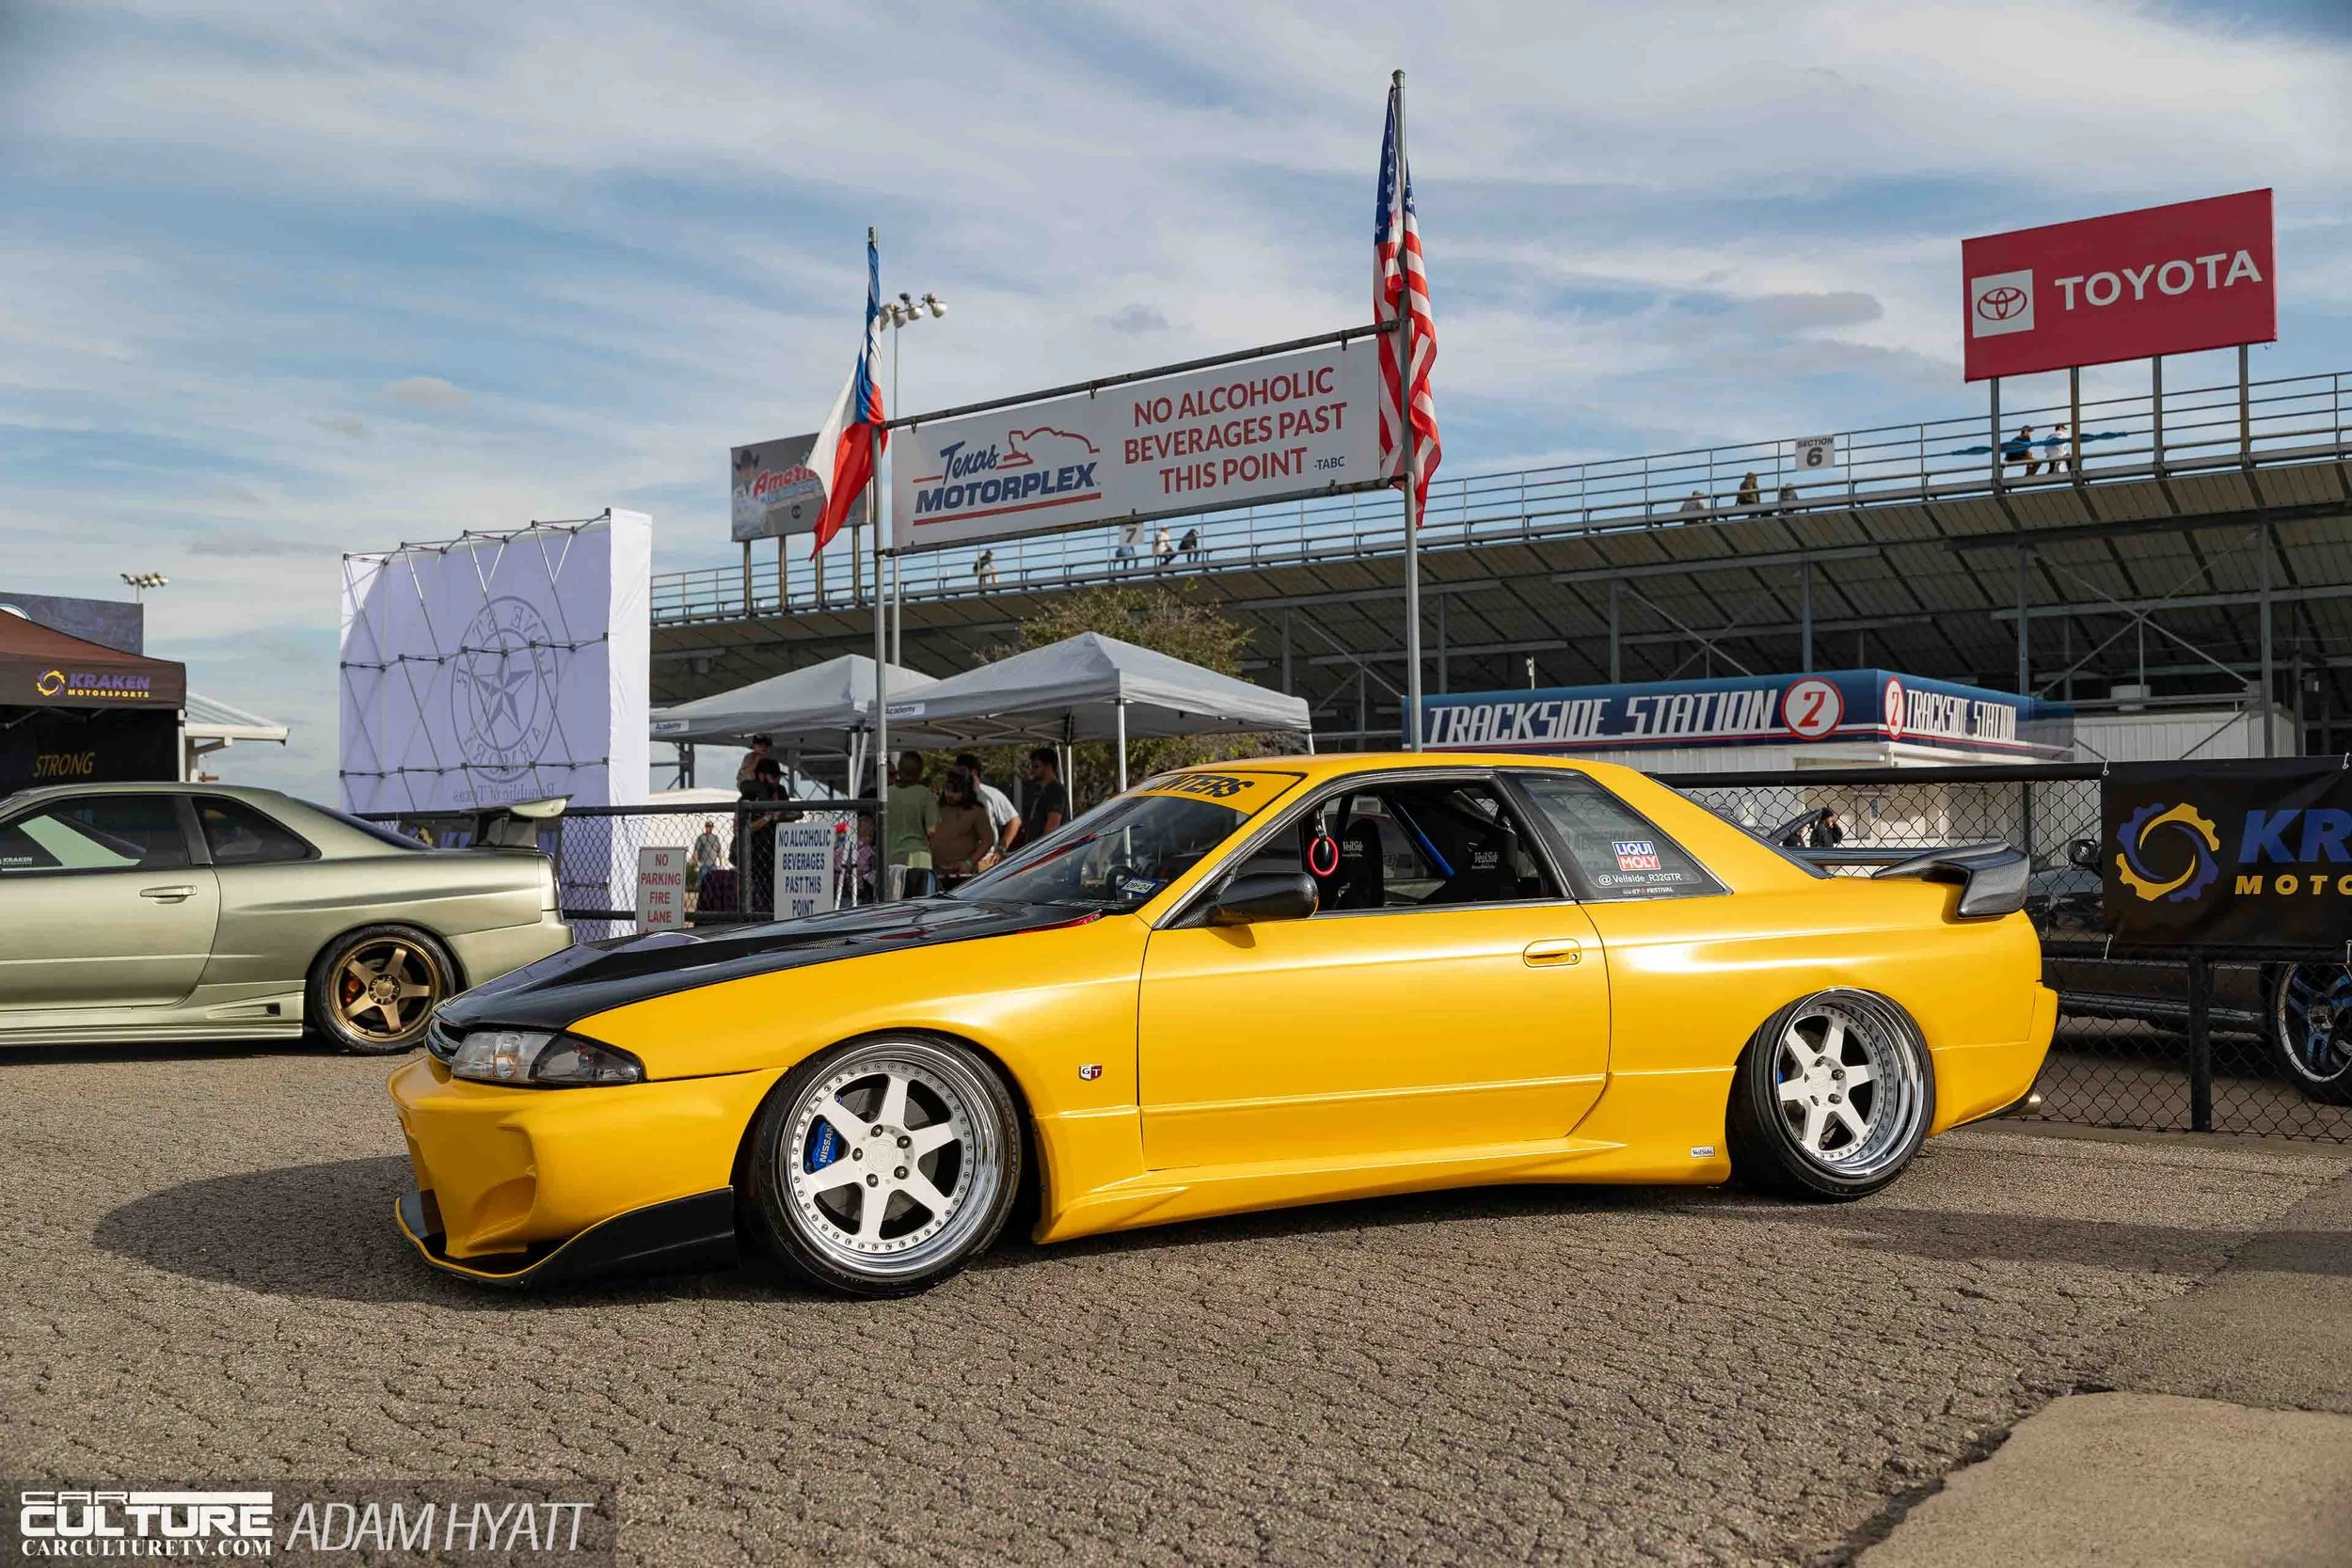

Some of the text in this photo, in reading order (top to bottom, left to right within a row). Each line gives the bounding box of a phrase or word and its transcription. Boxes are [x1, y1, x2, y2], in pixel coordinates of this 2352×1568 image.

[2055, 249, 2263, 310] TOYOTA
[1134, 366, 1334, 427] NO ALCOHOLIC
[1124, 402, 1347, 465] BEVERAGES PAST
[1797, 436, 1834, 448] SECTION
[940, 440, 1000, 484] Texas
[1806, 447, 1823, 467] 6
[1159, 447, 1345, 494] THIS POINT -TABC
[915, 462, 1098, 514] MOTORPLEX
[1126, 527, 1137, 544] 7
[68, 673, 151, 689] KRAKEN
[67, 689, 150, 698] MOTORSPORTS
[1430, 690, 1826, 745] TRACKSIDE STATION 2
[1890, 689, 2017, 741] 2 TRACKSIDE STATION
[34, 752, 96, 778] STRONG
[778, 830, 832, 847] NO ALCOHOLIC
[2238, 809, 2352, 863] KR
[1615, 843, 1653, 855] LIQUI
[655, 853, 669, 866] NO
[783, 853, 825, 870] BEVERAGES
[1620, 856, 1659, 868] MOLY
[641, 873, 681, 885] PARKING
[786, 876, 821, 894] PAST THIS
[650, 892, 671, 904] FIRE
[792, 899, 815, 916] POINT
[647, 911, 672, 923] LANE
[1081, 1067, 1101, 1077] GT
[818, 1126, 834, 1163] NISSAN
